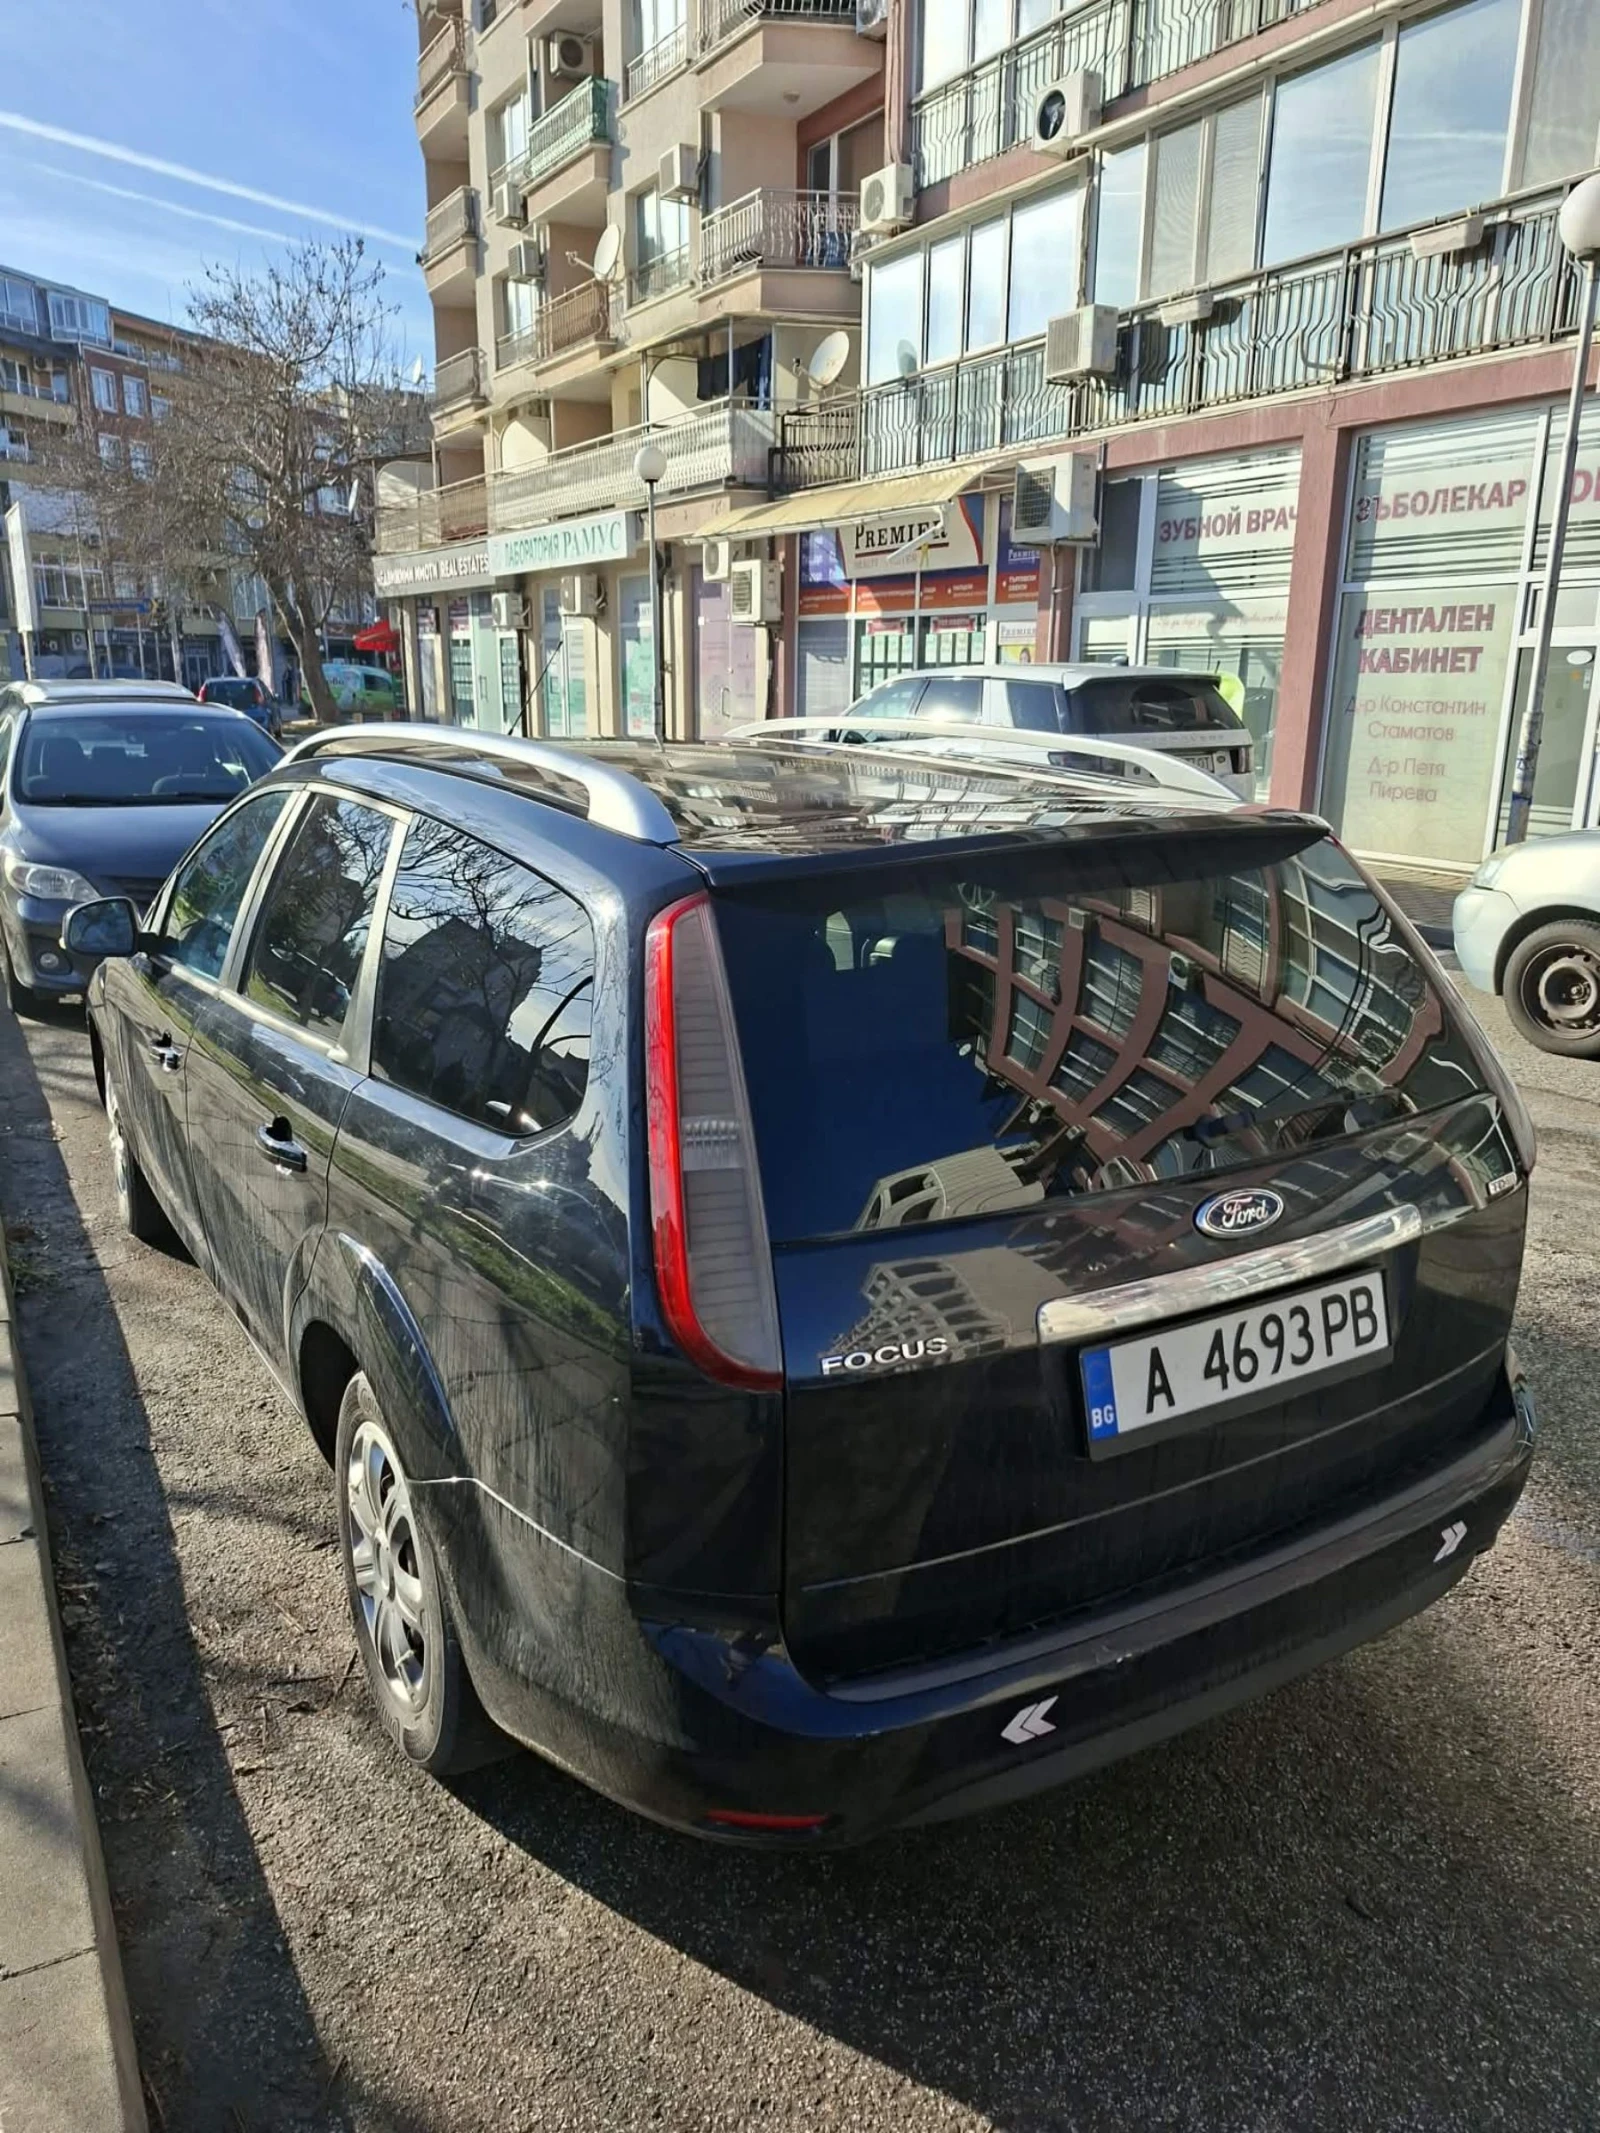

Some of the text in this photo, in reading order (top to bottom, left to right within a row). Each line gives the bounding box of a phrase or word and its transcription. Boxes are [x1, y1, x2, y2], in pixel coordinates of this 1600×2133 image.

[1356, 479, 1527, 523] ЗЪБОЛЕКАР
[563, 521, 621, 558] РАМУС
[1160, 506, 1241, 543] ЗУБНОЙ
[1354, 604, 1496, 639] ДЕНТАЛЕН
[1358, 647, 1484, 674] КАБИНЕТ
[1379, 695, 1486, 716] Константин
[1368, 721, 1454, 741] Стаматов
[1367, 756, 1446, 777] Д-р Петя
[1369, 781, 1438, 802] Пирева
[1222, 1196, 1269, 1229] Ford
[821, 1337, 949, 1375] FOCUS
[1091, 1405, 1115, 1430] BG
